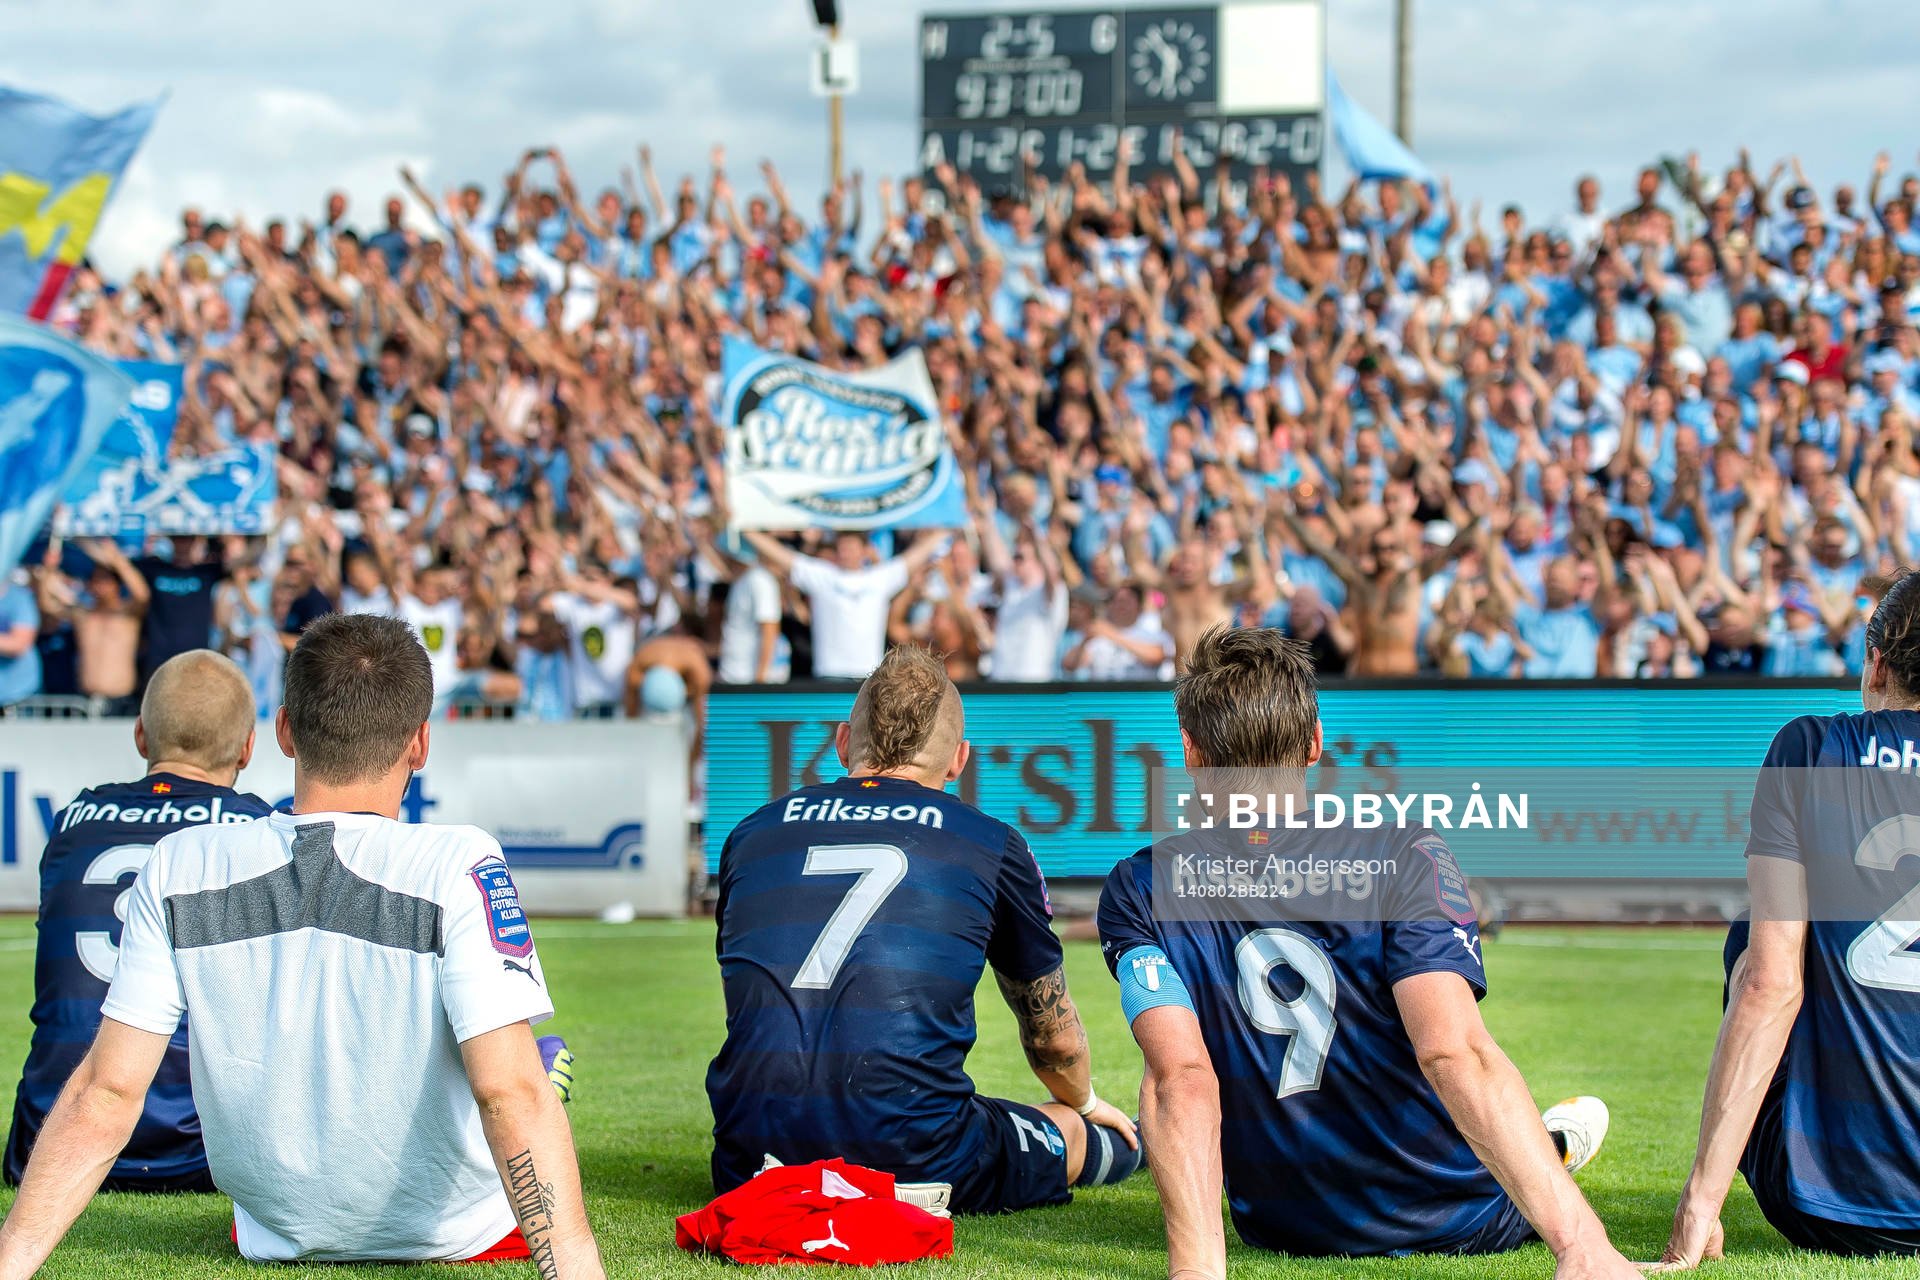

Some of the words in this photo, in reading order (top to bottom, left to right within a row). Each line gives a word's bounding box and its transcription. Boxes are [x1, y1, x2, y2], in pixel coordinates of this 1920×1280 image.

[981, 15, 1055, 60] 2-5
[819, 46, 850, 88] L
[60, 797, 257, 833] Tinnerholm
[782, 797, 943, 829] Eriksson
[790, 843, 909, 989] 7
[1233, 928, 1338, 1099] 9
